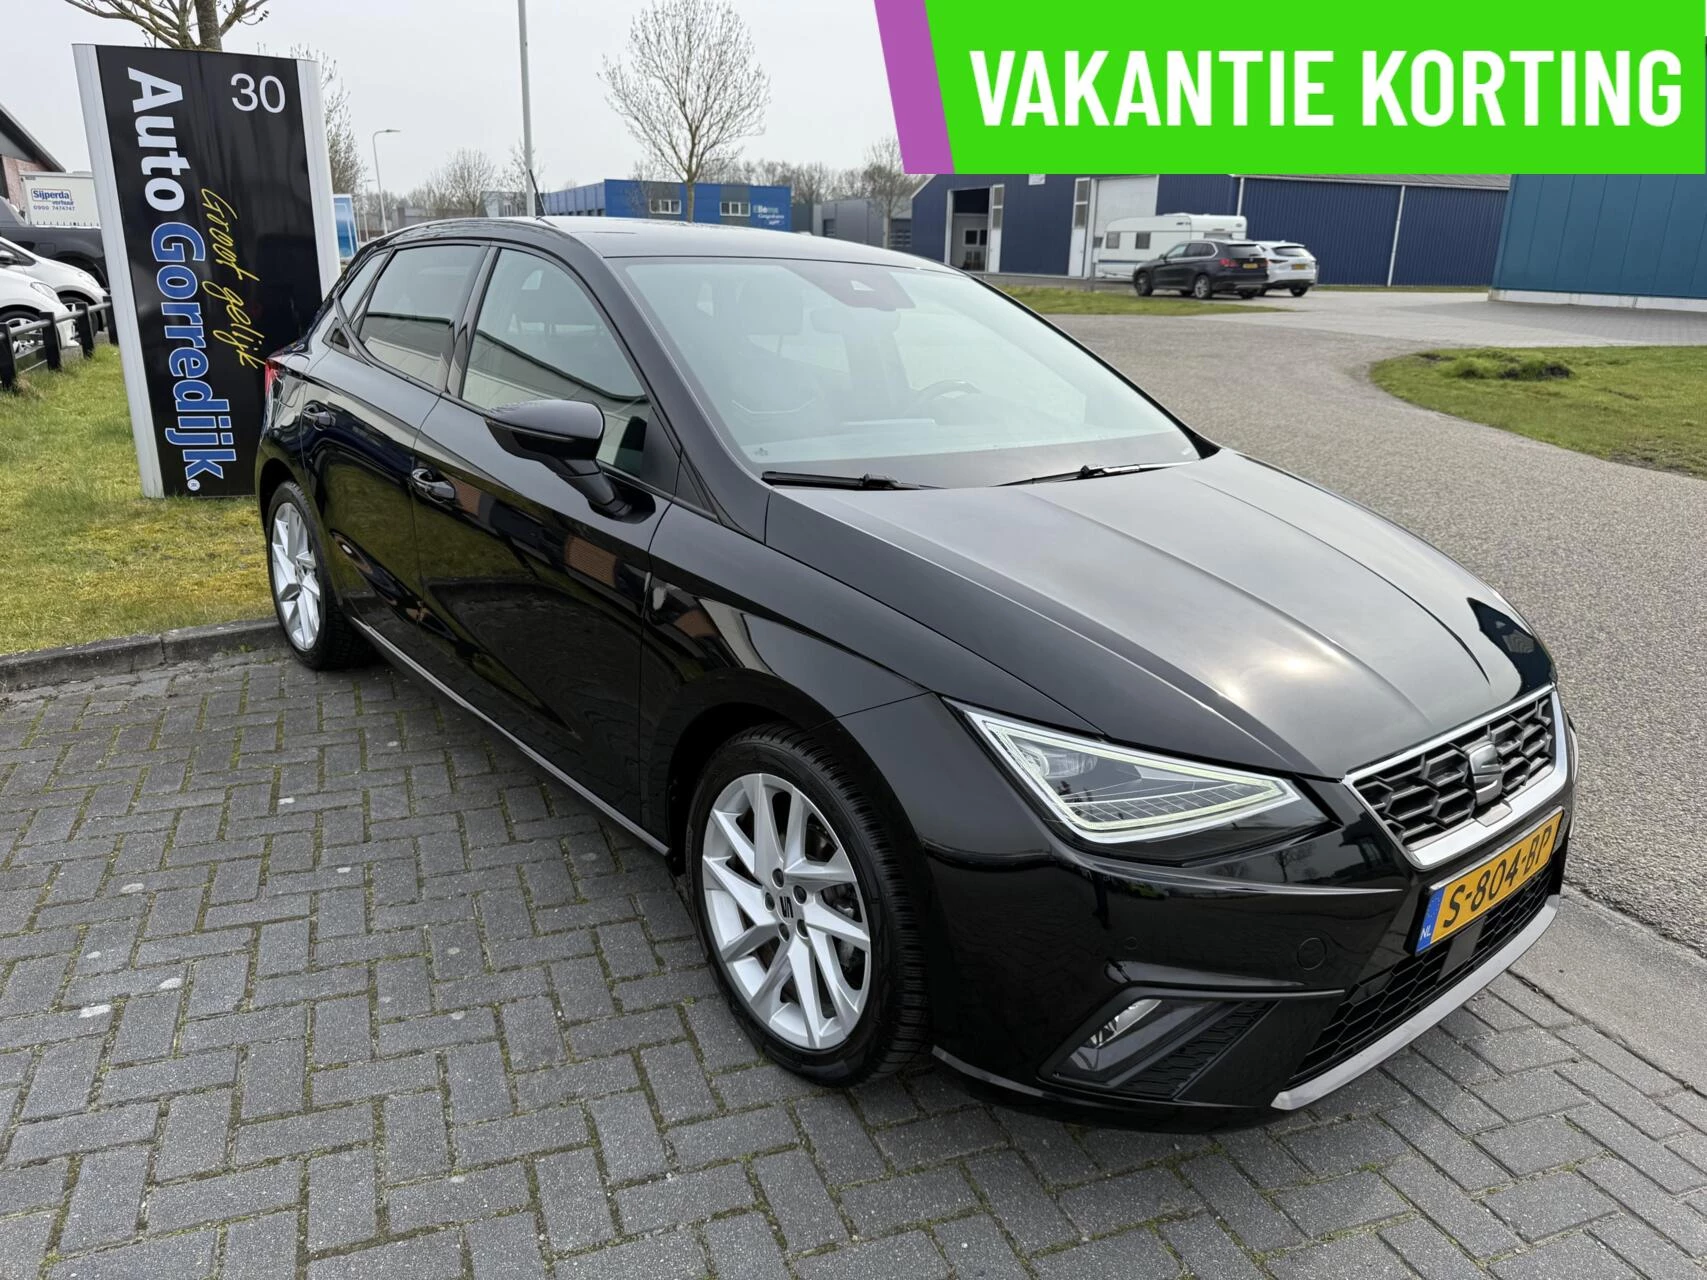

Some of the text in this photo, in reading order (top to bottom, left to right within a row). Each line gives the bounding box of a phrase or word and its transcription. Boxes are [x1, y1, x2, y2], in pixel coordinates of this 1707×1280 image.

[230, 72, 286, 114] 30
[127, 66, 191, 212] Auto
[33, 190, 70, 200] Sijperda
[201, 188, 266, 369] Groot gelijk
[1442, 824, 1553, 929] S-804-BP
[1419, 924, 1432, 941] NL
